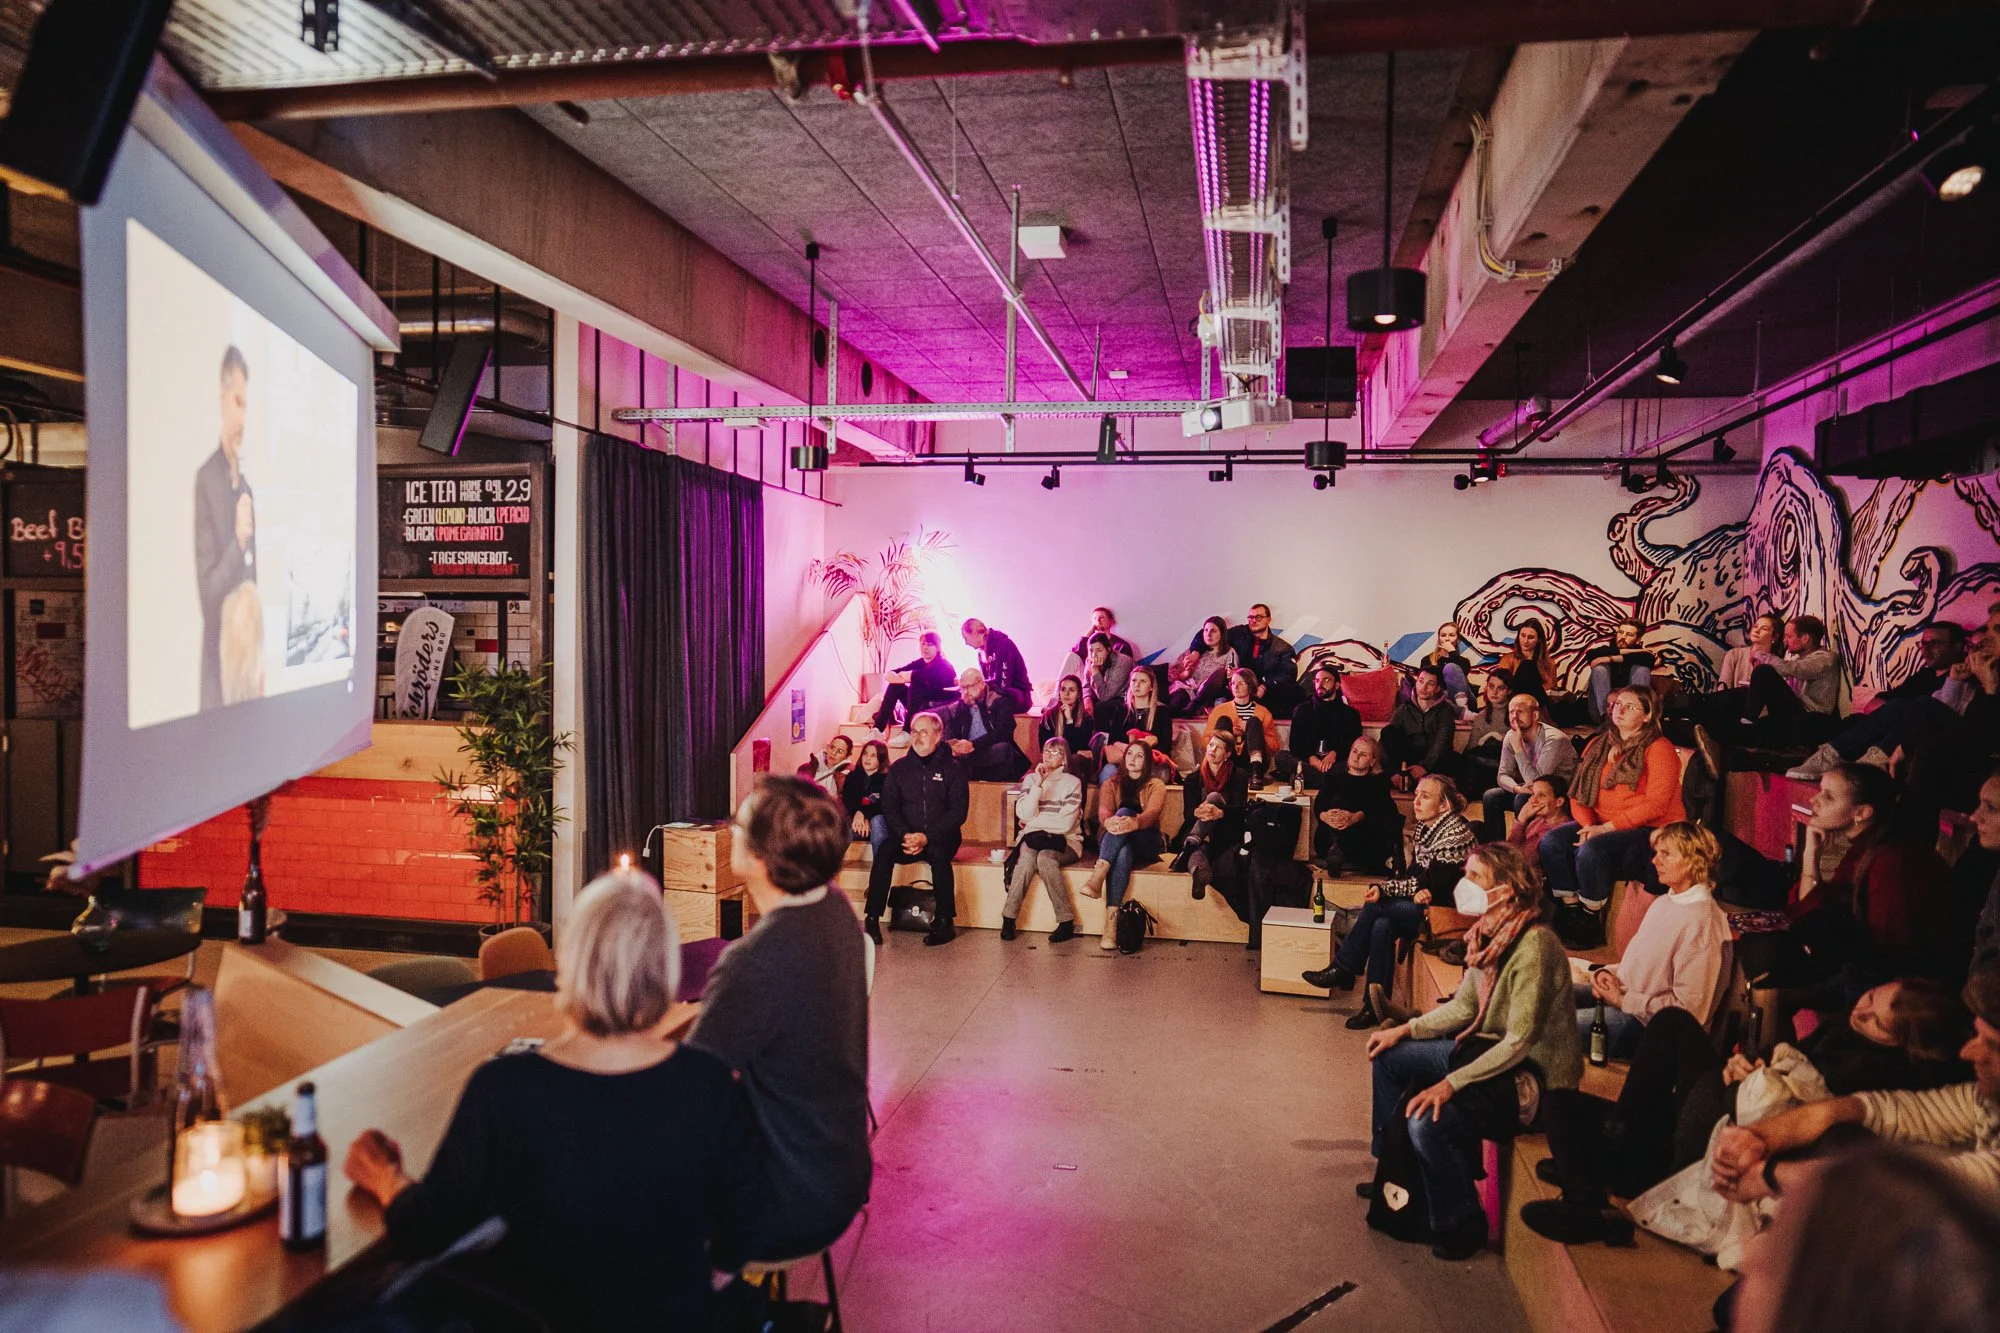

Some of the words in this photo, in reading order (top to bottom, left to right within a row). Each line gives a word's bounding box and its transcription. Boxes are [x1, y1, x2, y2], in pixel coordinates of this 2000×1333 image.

[406, 481, 428, 503] ICE
[429, 480, 456, 503] TEA
[460, 480, 482, 491] HOME
[460, 490, 482, 502] MADE
[10, 509, 58, 541] Beef
